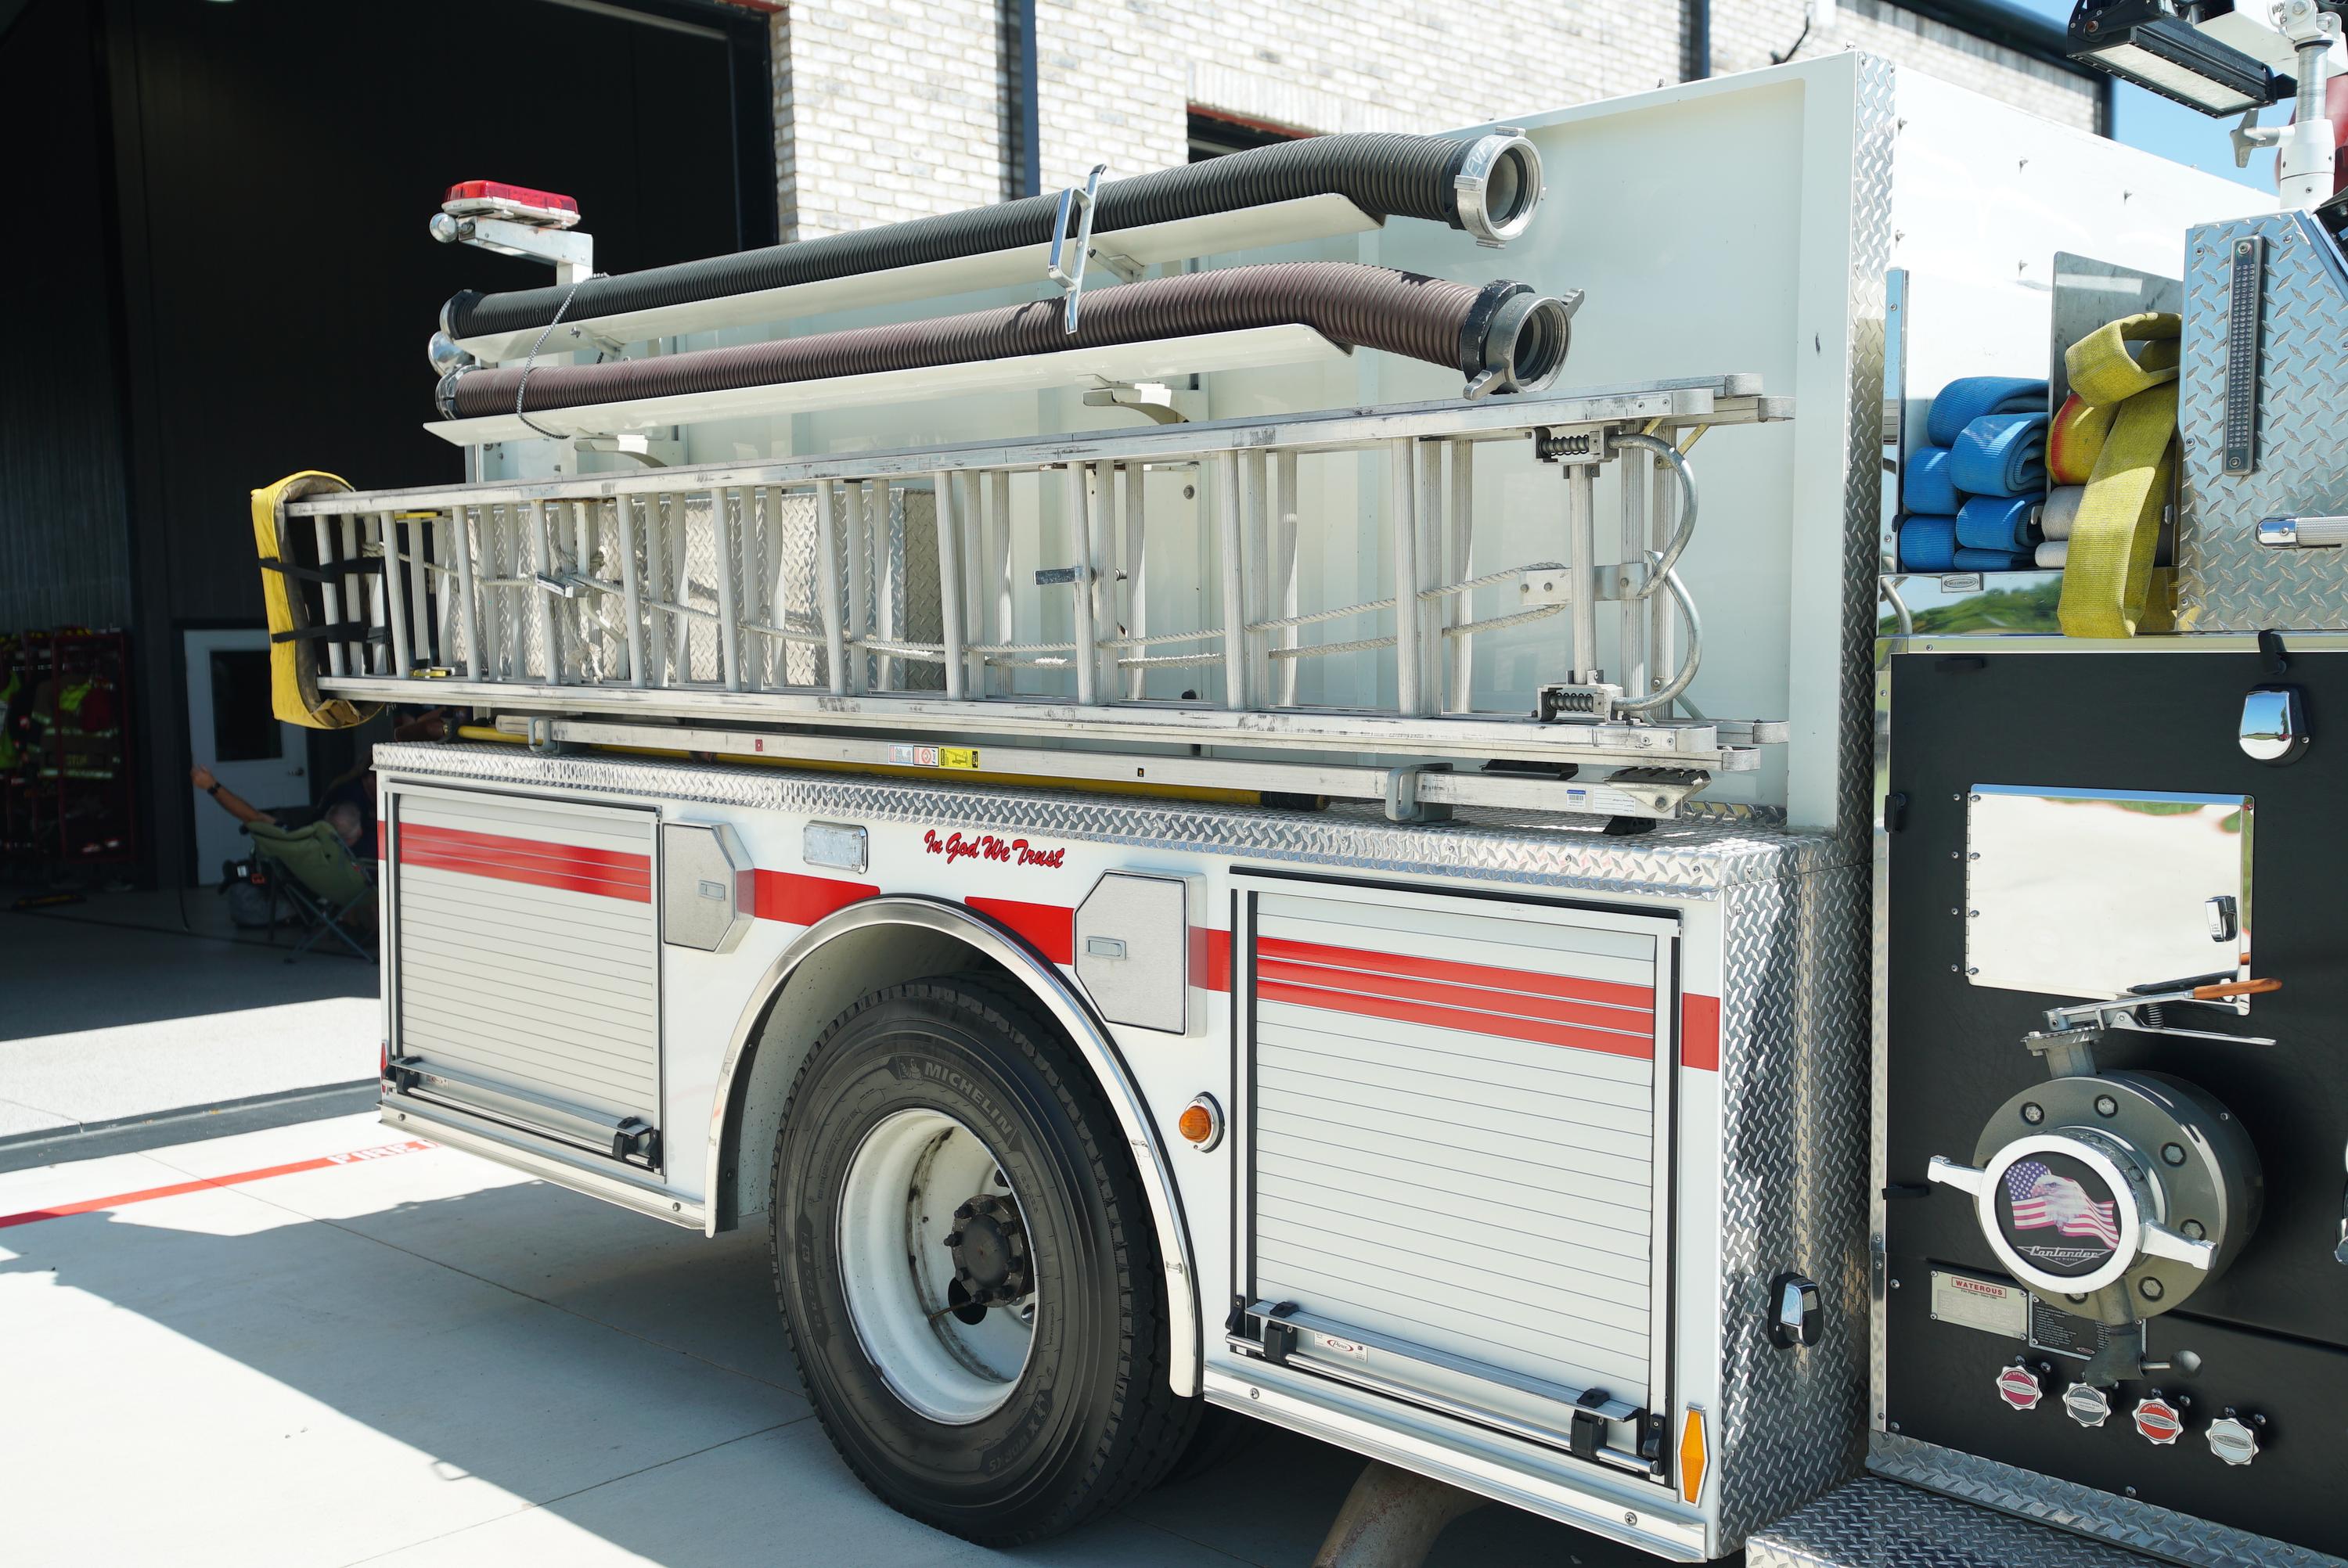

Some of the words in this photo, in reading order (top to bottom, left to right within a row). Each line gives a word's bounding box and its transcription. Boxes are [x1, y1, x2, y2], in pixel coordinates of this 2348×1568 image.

[924, 829, 943, 854] In
[945, 832, 981, 864] God
[981, 835, 1010, 862] We
[1012, 839, 1065, 869] Trust
[924, 1062, 1014, 1135] MICHELIN
[326, 1142, 420, 1164] FIRE
[2029, 1246, 2100, 1258] Contender
[1955, 1280, 2003, 1296] WATEROUS
